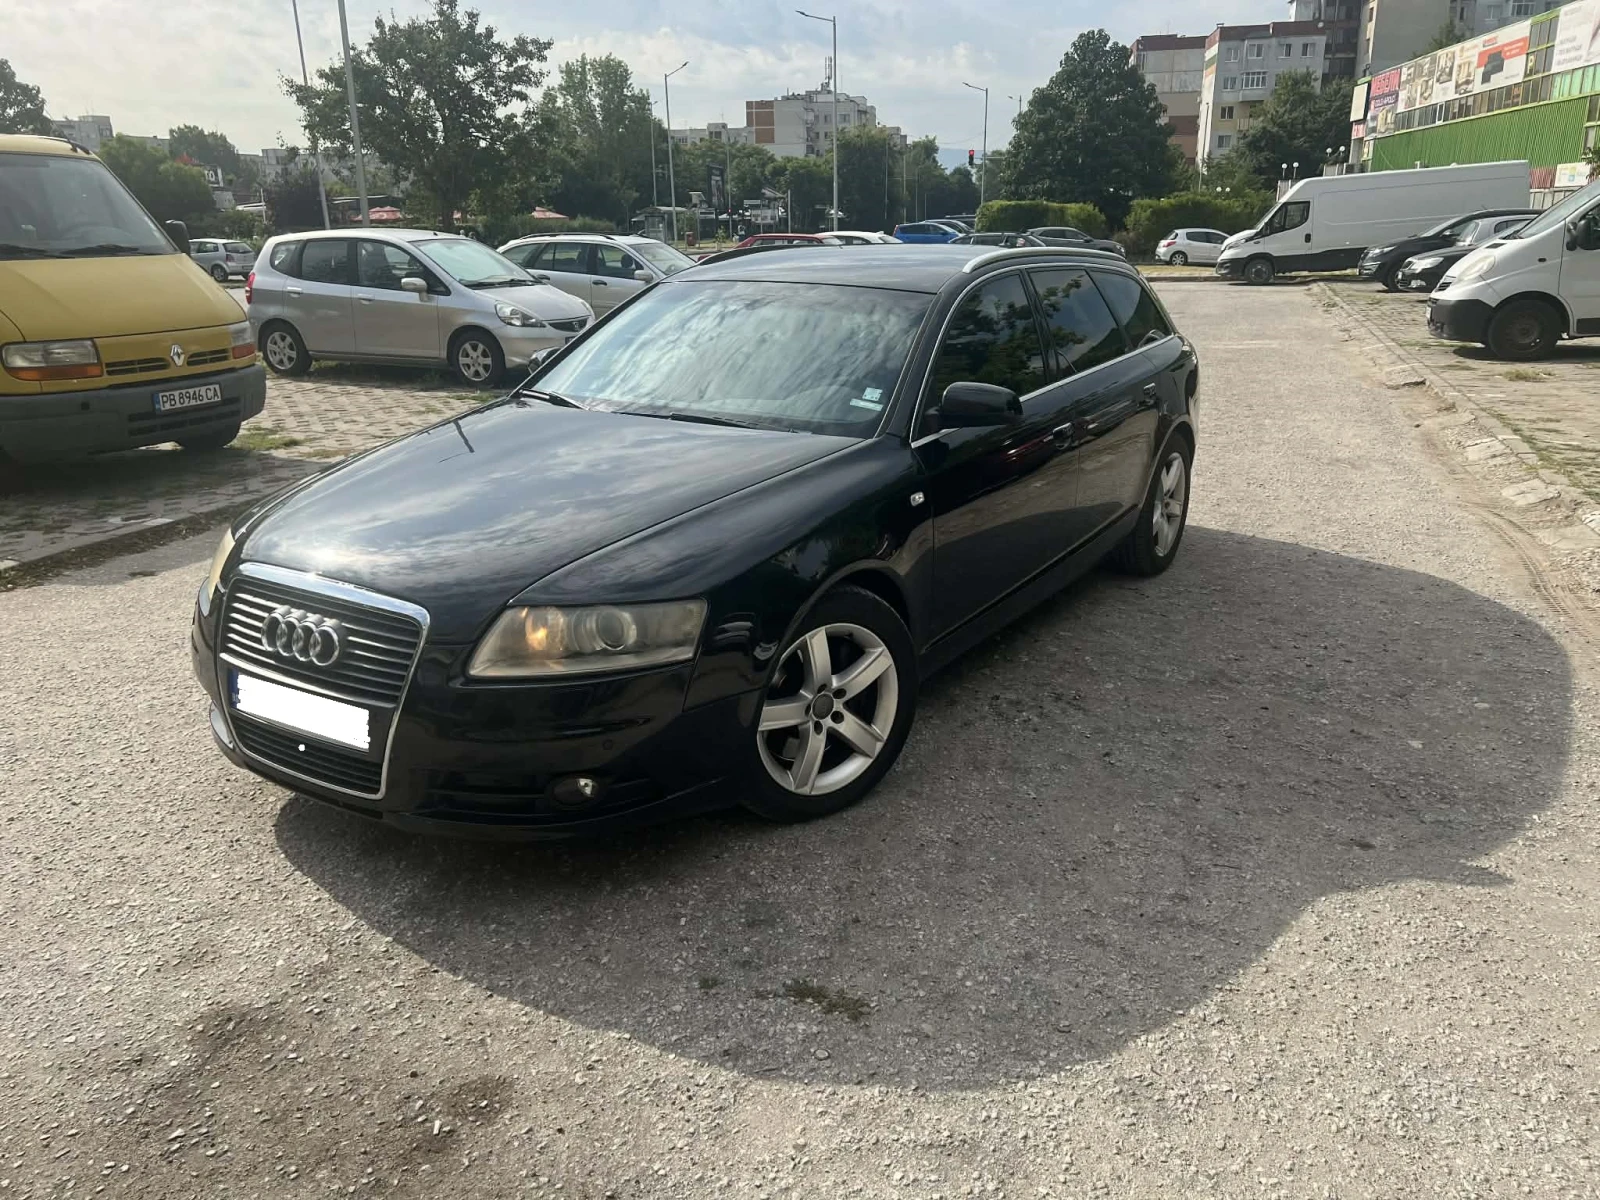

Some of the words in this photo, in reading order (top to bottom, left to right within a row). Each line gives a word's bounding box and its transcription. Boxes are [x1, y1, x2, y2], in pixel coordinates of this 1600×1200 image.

[1371, 69, 1400, 96] МЕБЕЛИ
[161, 394, 177, 408] PB
[178, 389, 204, 405] 8946
[205, 387, 219, 400] CA
